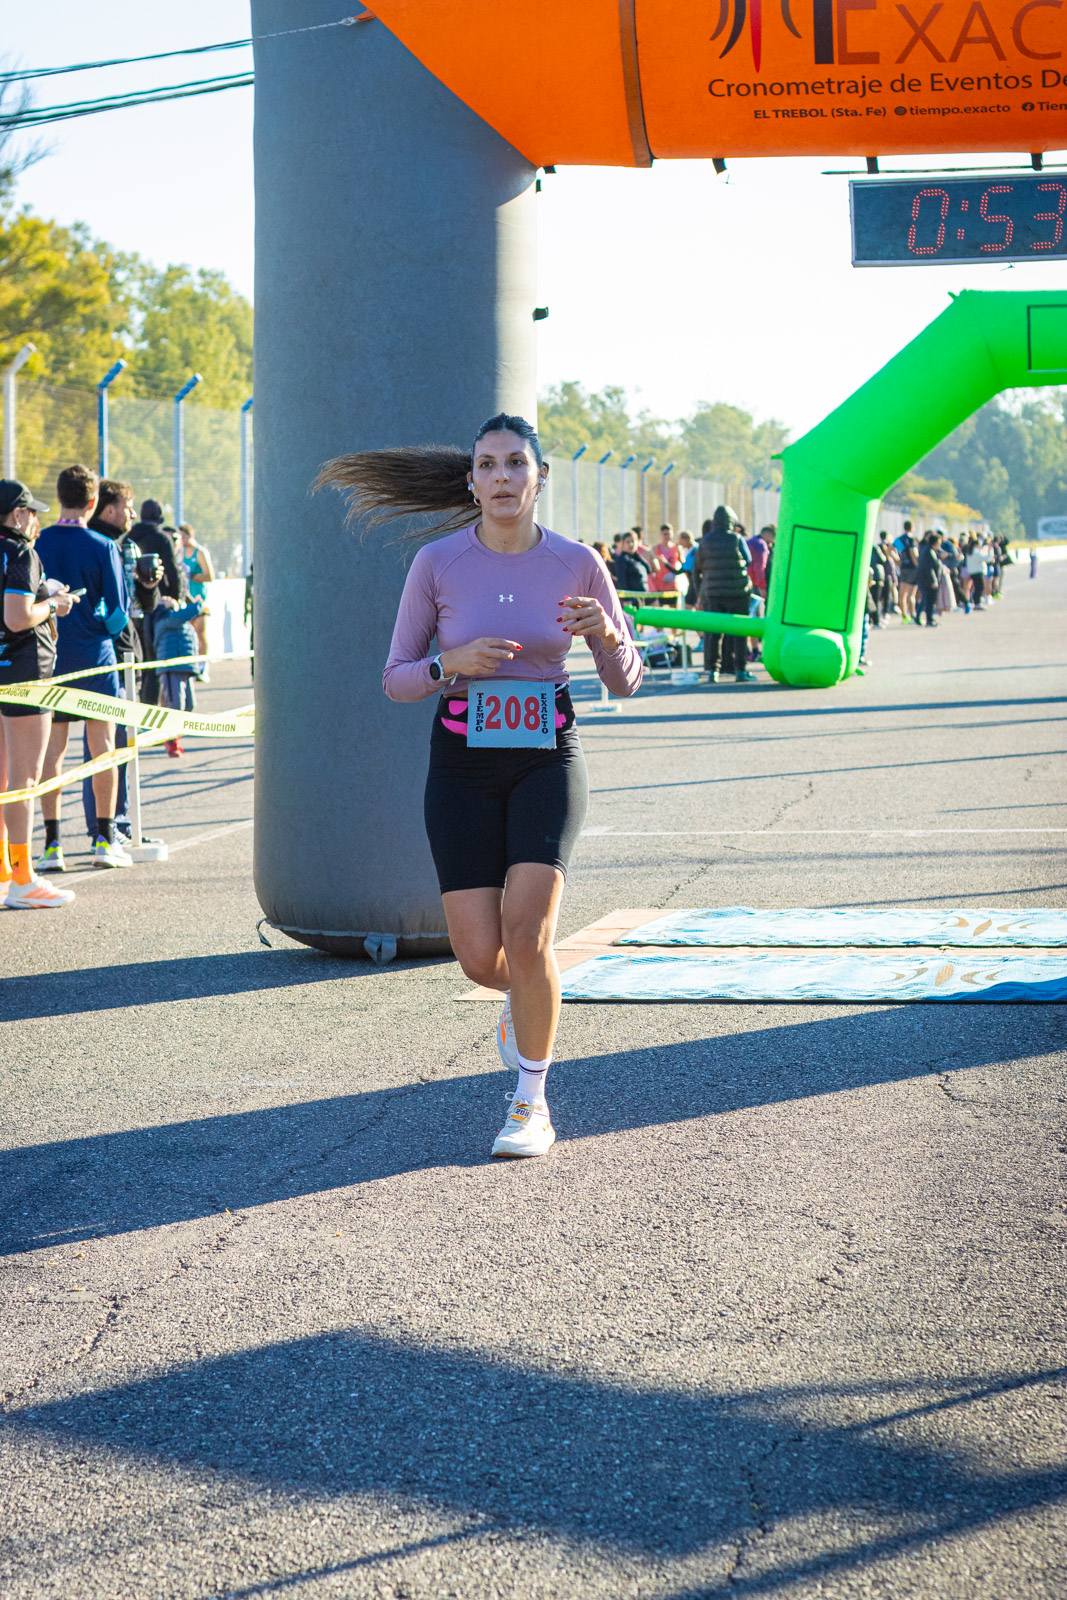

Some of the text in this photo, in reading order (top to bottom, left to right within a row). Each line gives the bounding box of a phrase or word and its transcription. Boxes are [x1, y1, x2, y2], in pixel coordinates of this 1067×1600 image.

[708, 77, 883, 98] Cronometraje
[890, 74, 922, 93] de
[930, 71, 1033, 92] Eventos
[754, 109, 771, 119] EL
[772, 108, 828, 119] TREBOL
[831, 107, 863, 118] (Sta.
[866, 106, 887, 117] Fe)
[909, 103, 1011, 116] tiempo.exacto
[907, 183, 1067, 255] 0:53
[77, 698, 126, 718] PRECAUCION
[476, 693, 484, 732] TIEMPO
[485, 695, 540, 730] 208
[183, 720, 236, 732] PRECAUCION
